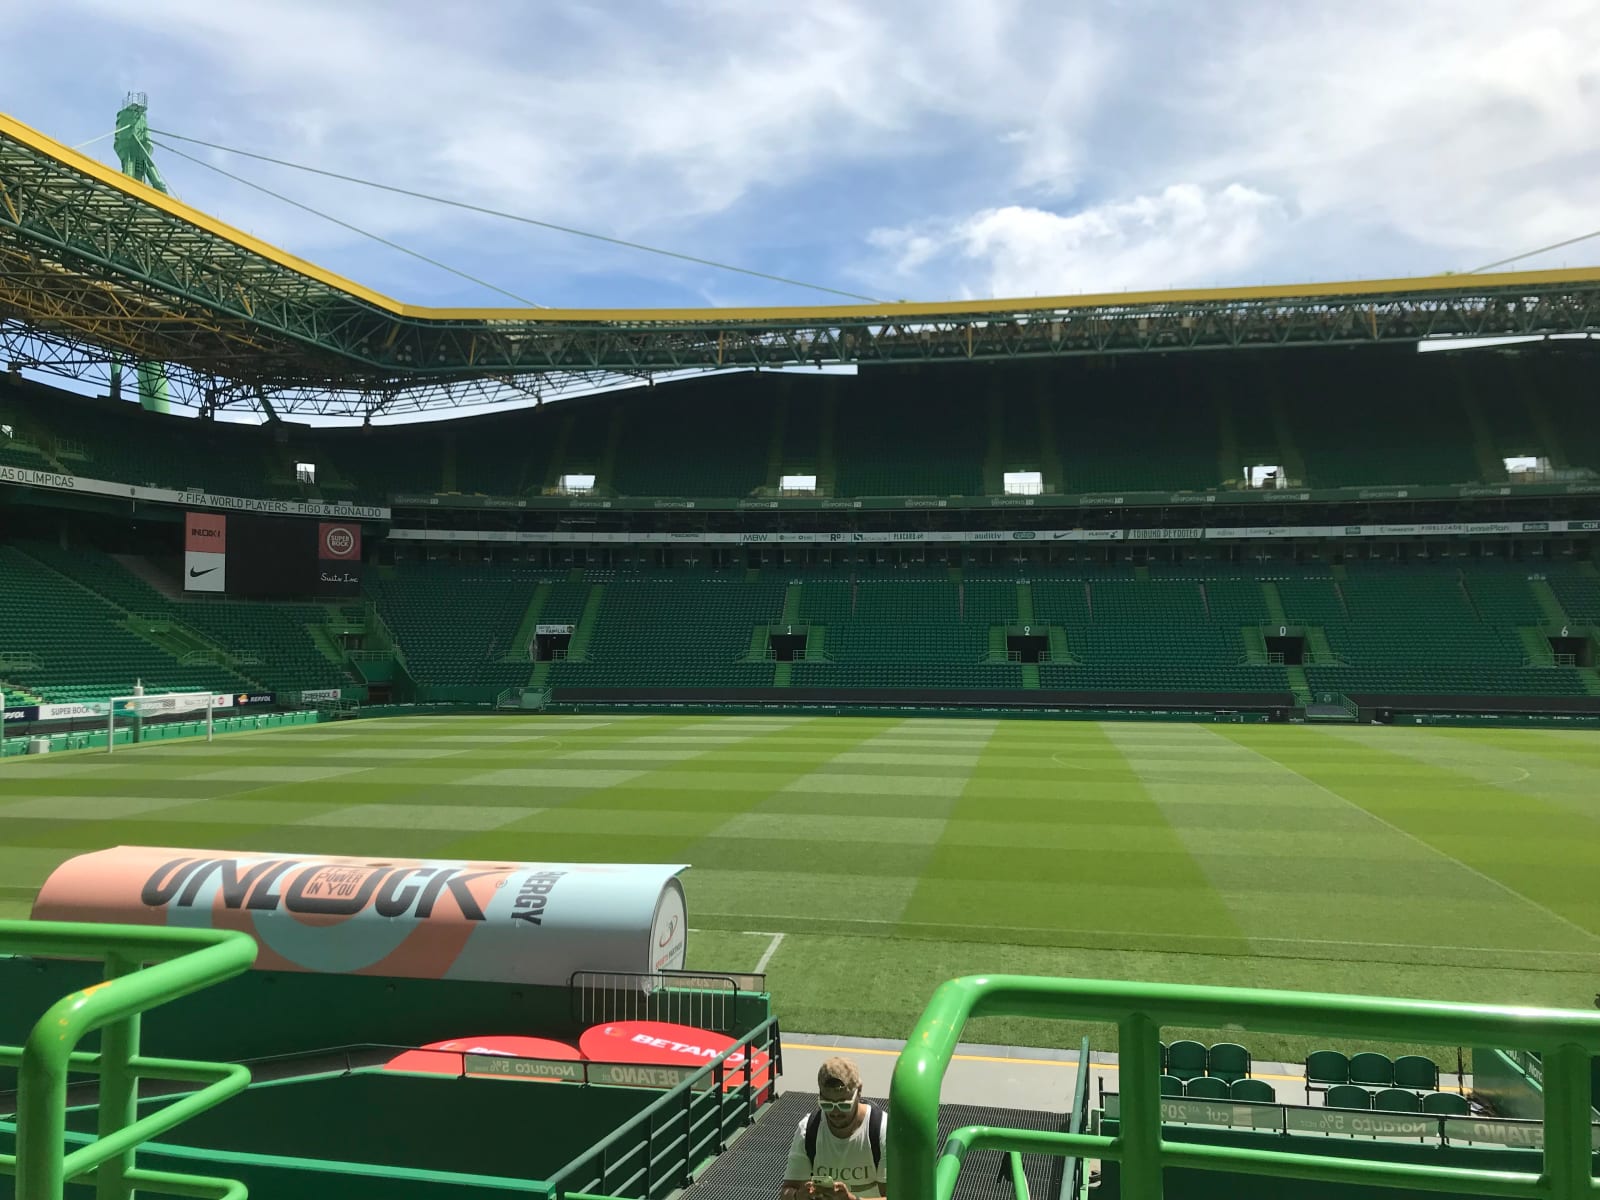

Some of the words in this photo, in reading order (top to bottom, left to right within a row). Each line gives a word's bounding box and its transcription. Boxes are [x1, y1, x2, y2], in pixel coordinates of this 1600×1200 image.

[177, 492, 184, 502] 2
[186, 493, 207, 504] FIFA
[210, 495, 243, 508] WORLD
[245, 499, 288, 512] PLAYERS
[298, 503, 321, 514] FIGO
[323, 505, 331, 514] &
[334, 506, 382, 517] RONALDO
[786, 625, 793, 635] 1
[1561, 625, 1569, 637] 6
[51, 707, 71, 716] SUPER
[72, 706, 90, 714] BOCK
[315, 872, 363, 883] POWER
[140, 857, 512, 921] UNLOCK
[306, 882, 323, 895] IN
[328, 883, 356, 896] YOU
[816, 1166, 869, 1180] GUCCI
